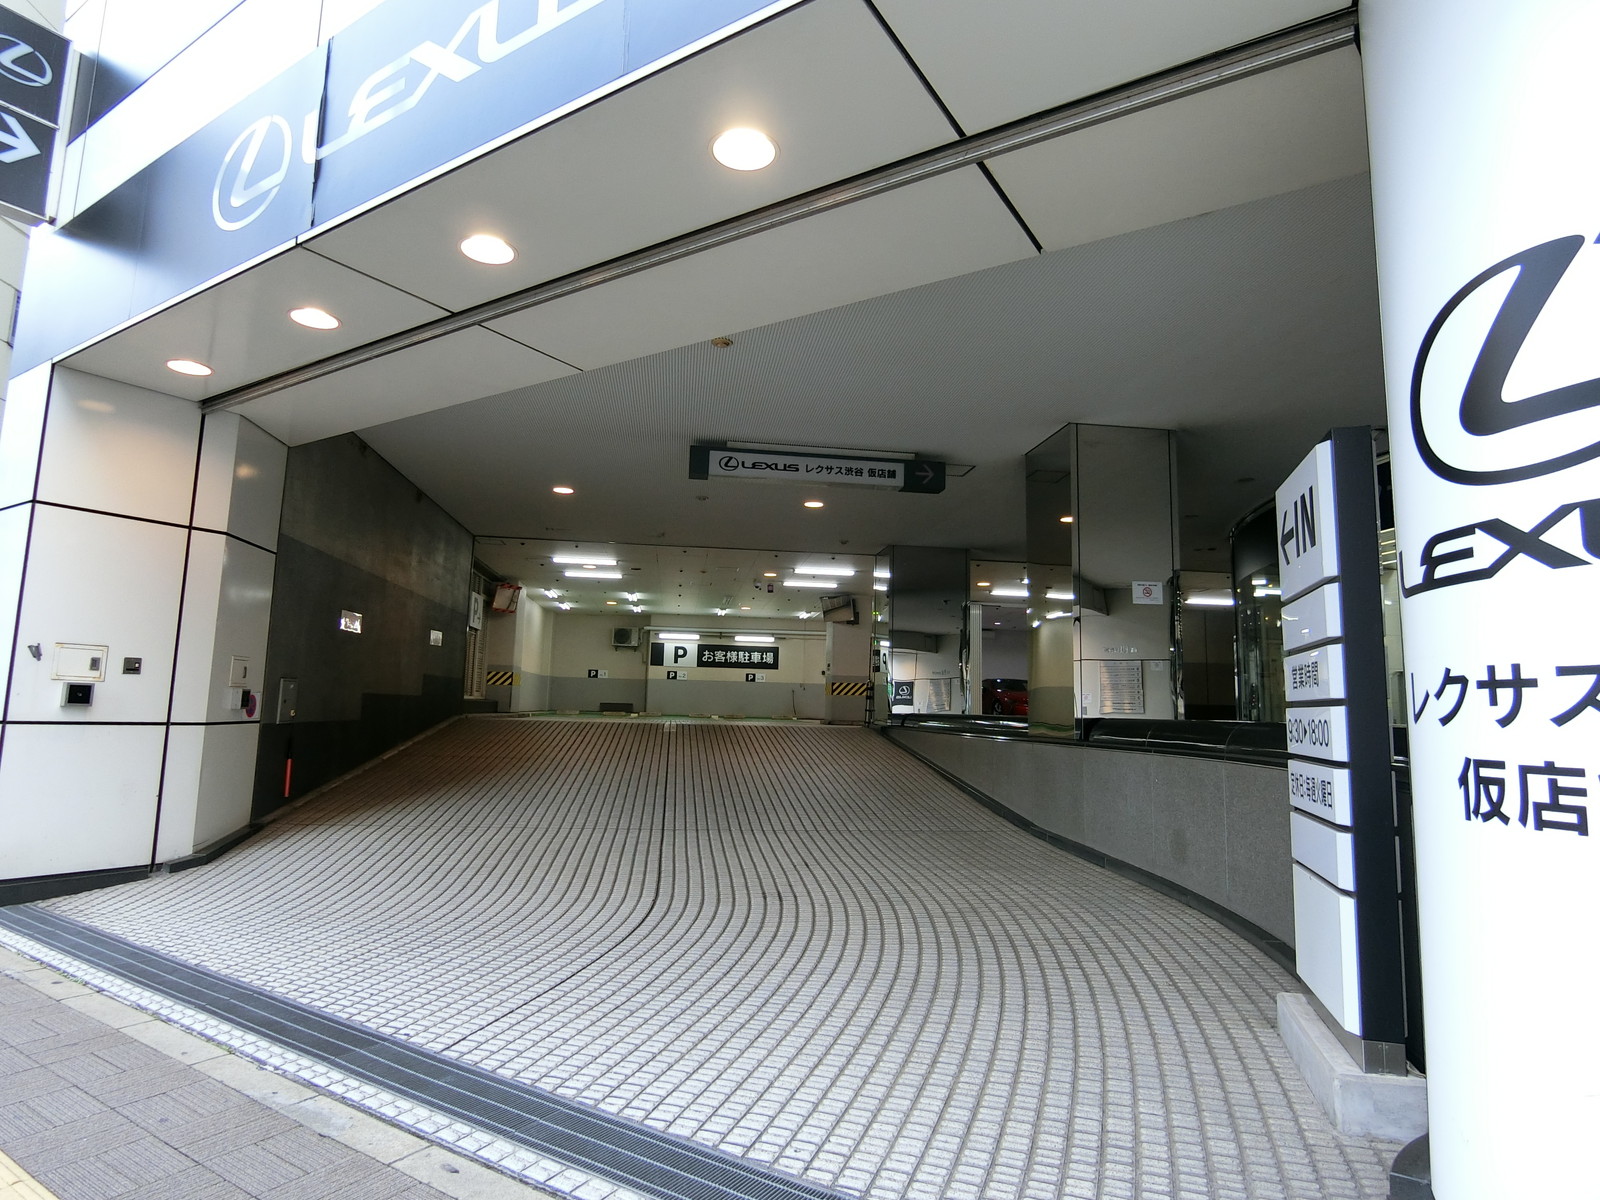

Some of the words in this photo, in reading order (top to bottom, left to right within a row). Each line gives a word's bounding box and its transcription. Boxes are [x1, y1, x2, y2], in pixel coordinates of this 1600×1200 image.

[302, 0, 606, 164] LEXU
[741, 461, 800, 473] LEXUS
[805, 464, 864, 477] レクサス渋谷
[867, 467, 897, 479] 仮店舗
[1294, 485, 1316, 558] IN
[673, 645, 688, 664] P
[701, 650, 774, 664] お客様駐車場
[1291, 660, 1319, 690] 営業時間
